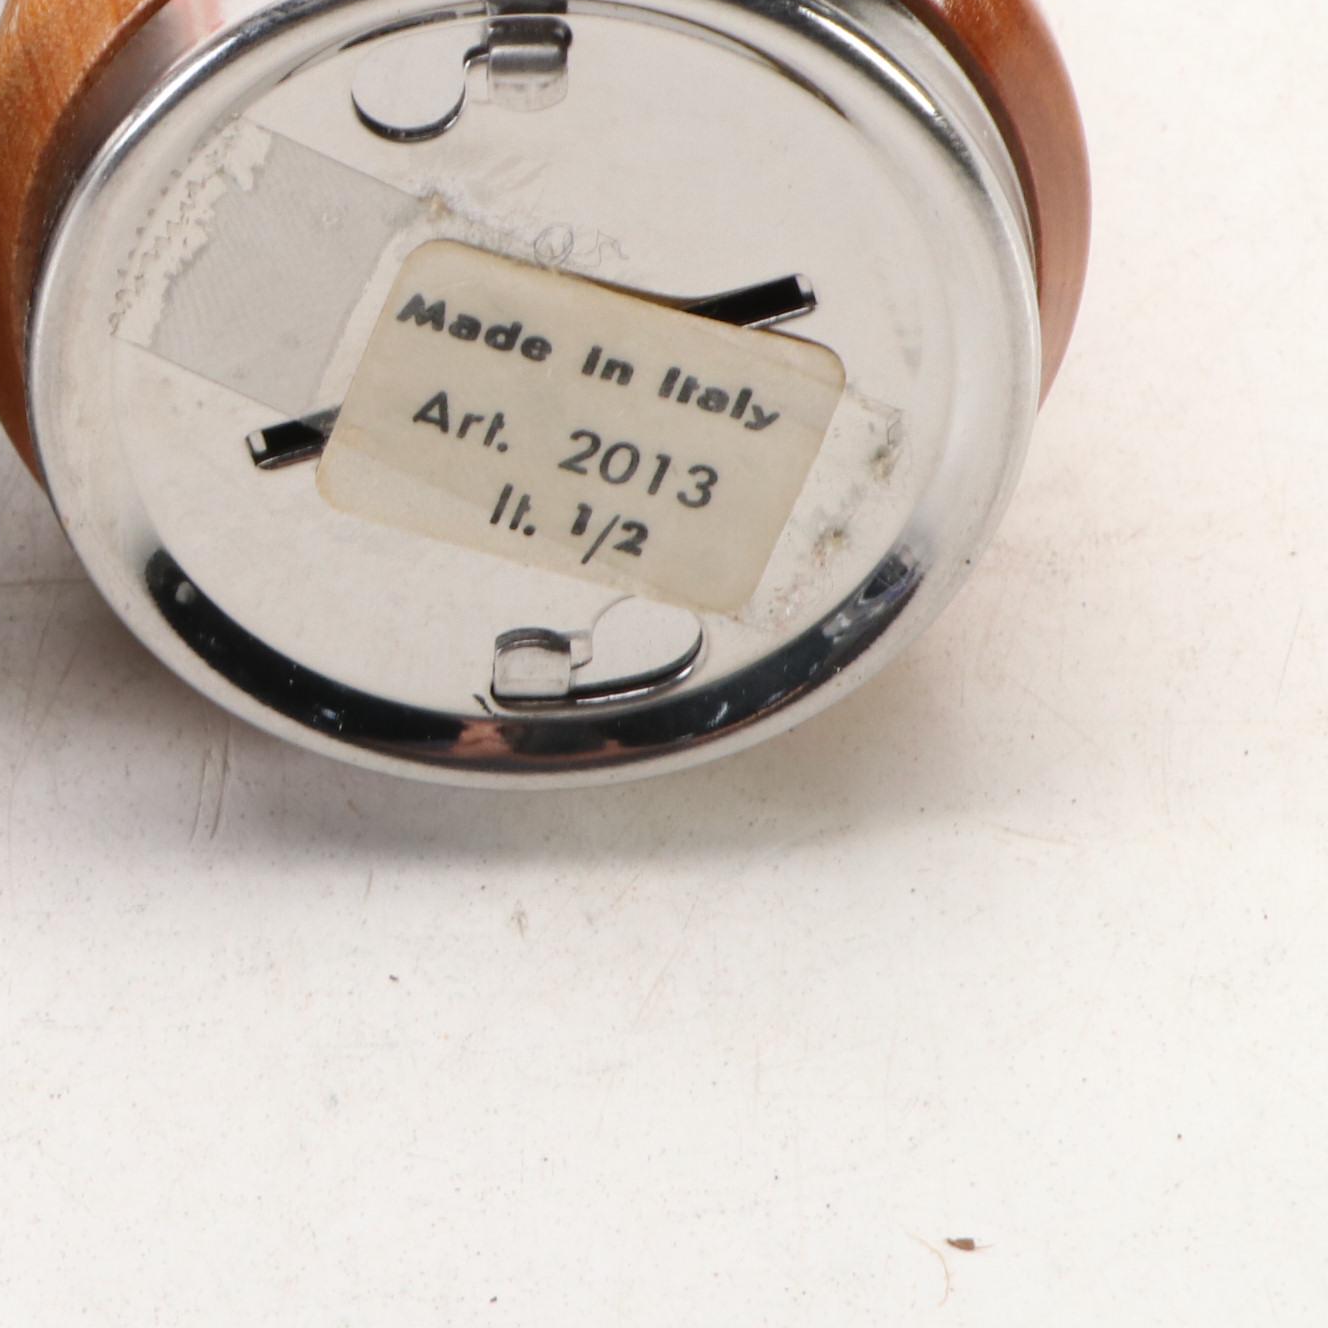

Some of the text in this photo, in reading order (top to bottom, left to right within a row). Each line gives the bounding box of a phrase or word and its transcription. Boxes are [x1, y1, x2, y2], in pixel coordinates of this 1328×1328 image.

[395, 292, 553, 362] Made
[657, 366, 781, 432] Italy
[412, 390, 720, 509] Art. 2013
[569, 502, 650, 565] 1/2
